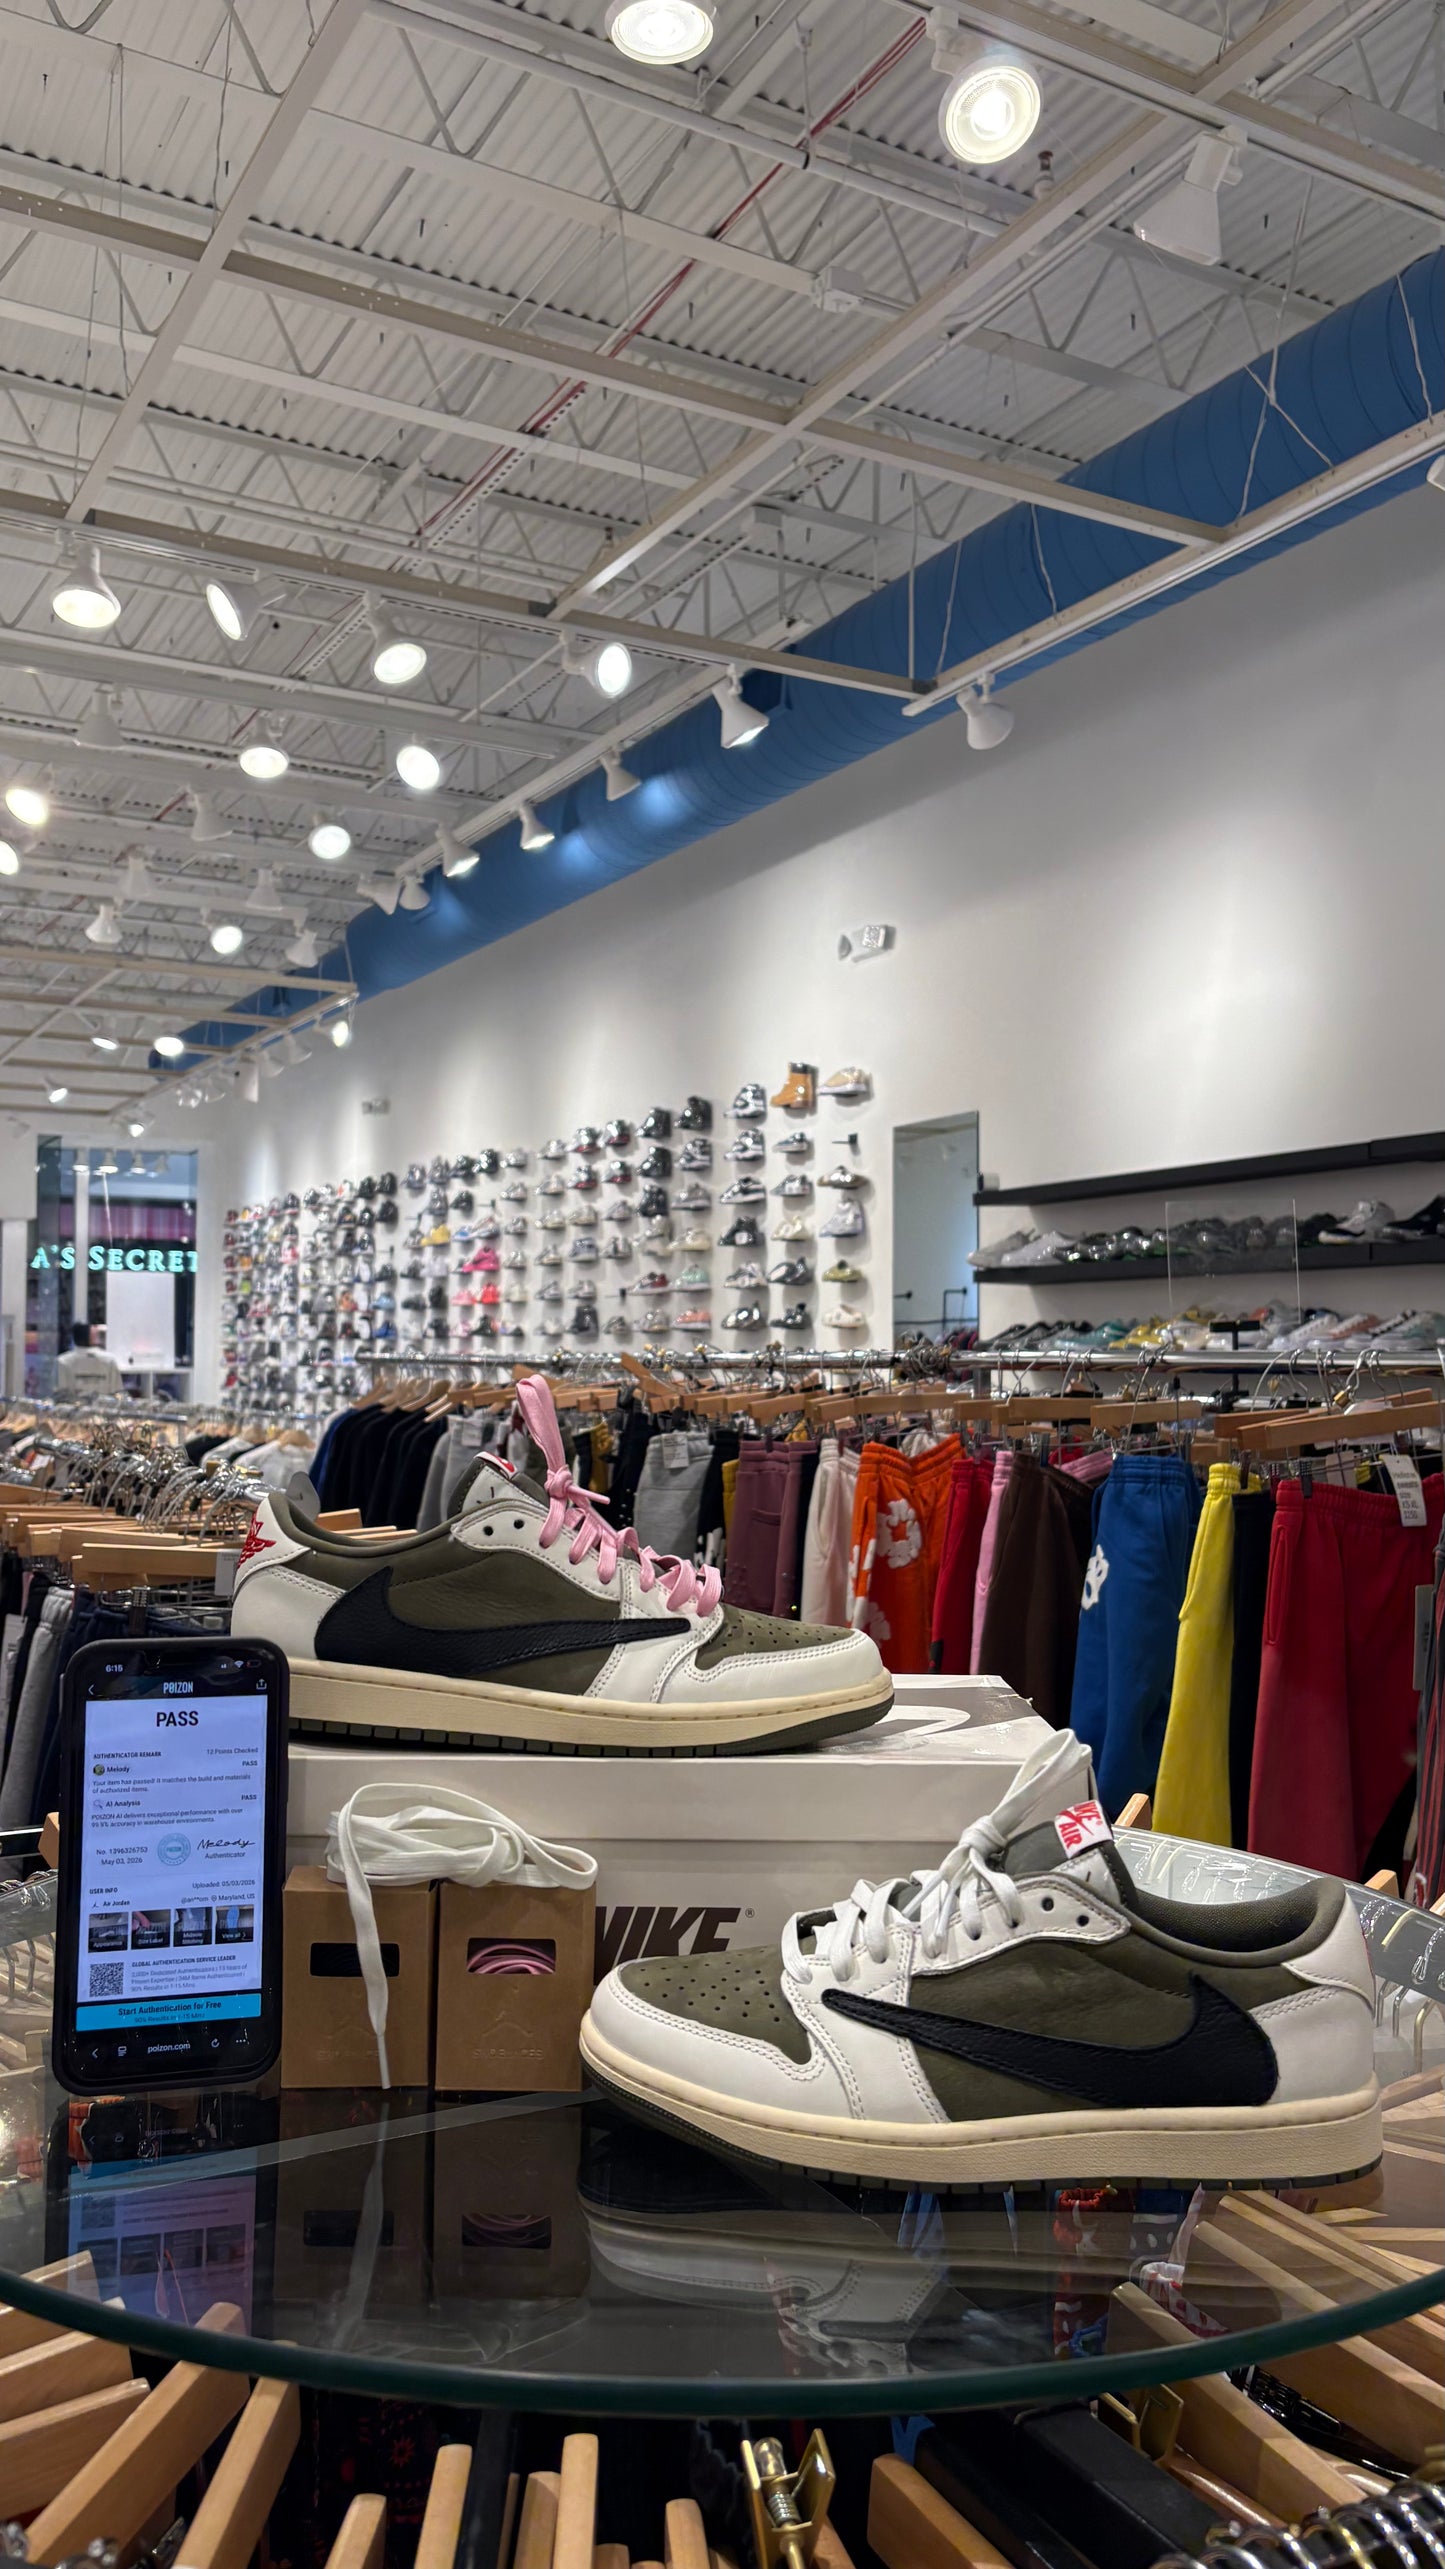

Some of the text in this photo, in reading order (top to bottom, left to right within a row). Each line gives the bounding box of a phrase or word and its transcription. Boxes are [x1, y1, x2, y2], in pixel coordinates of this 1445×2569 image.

[156, 1710, 199, 1727] PASS
[147, 1810, 179, 1818] exceptional
[1058, 1822, 1083, 1850] AIR
[101, 1858, 115, 1866] May
[152, 1957, 195, 1966] AUTHENTICATION
[118, 2007, 137, 2016] Start
[138, 2004, 192, 2014] Authentication
[205, 2001, 222, 2009] Free
[147, 2041, 191, 2054] poizon.com
